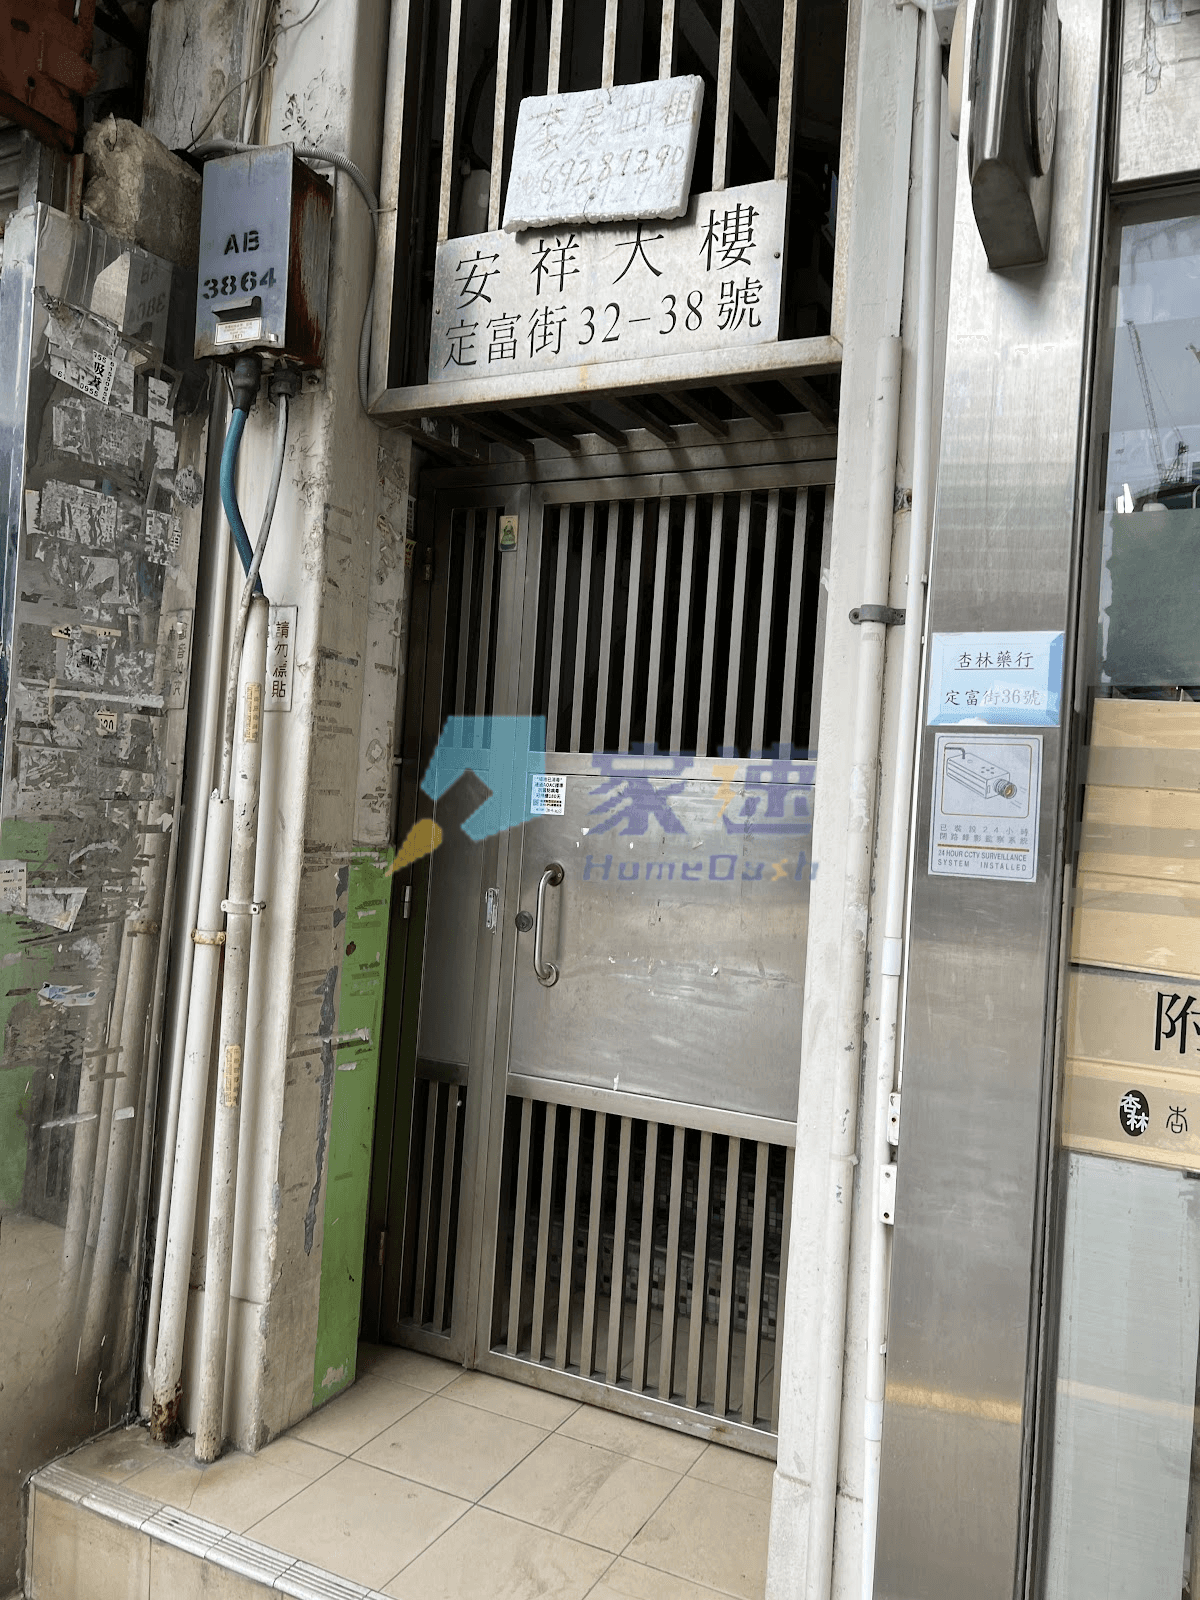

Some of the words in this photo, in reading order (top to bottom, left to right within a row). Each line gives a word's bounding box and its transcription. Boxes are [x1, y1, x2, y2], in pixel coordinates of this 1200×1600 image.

[224, 229, 260, 255] AB
[454, 203, 760, 310] 安祥大樓
[202, 267, 277, 299] 3864
[442, 276, 764, 370] 定富街32-38號
[958, 650, 1034, 668] 杏林藥行
[944, 688, 1041, 706] 定富街36號
[938, 859, 970, 867] SYSTEM
[980, 861, 1027, 871] INSTALLED
[964, 851, 980, 859] CCTV
[981, 852, 1027, 862] SURVEILLANCE
